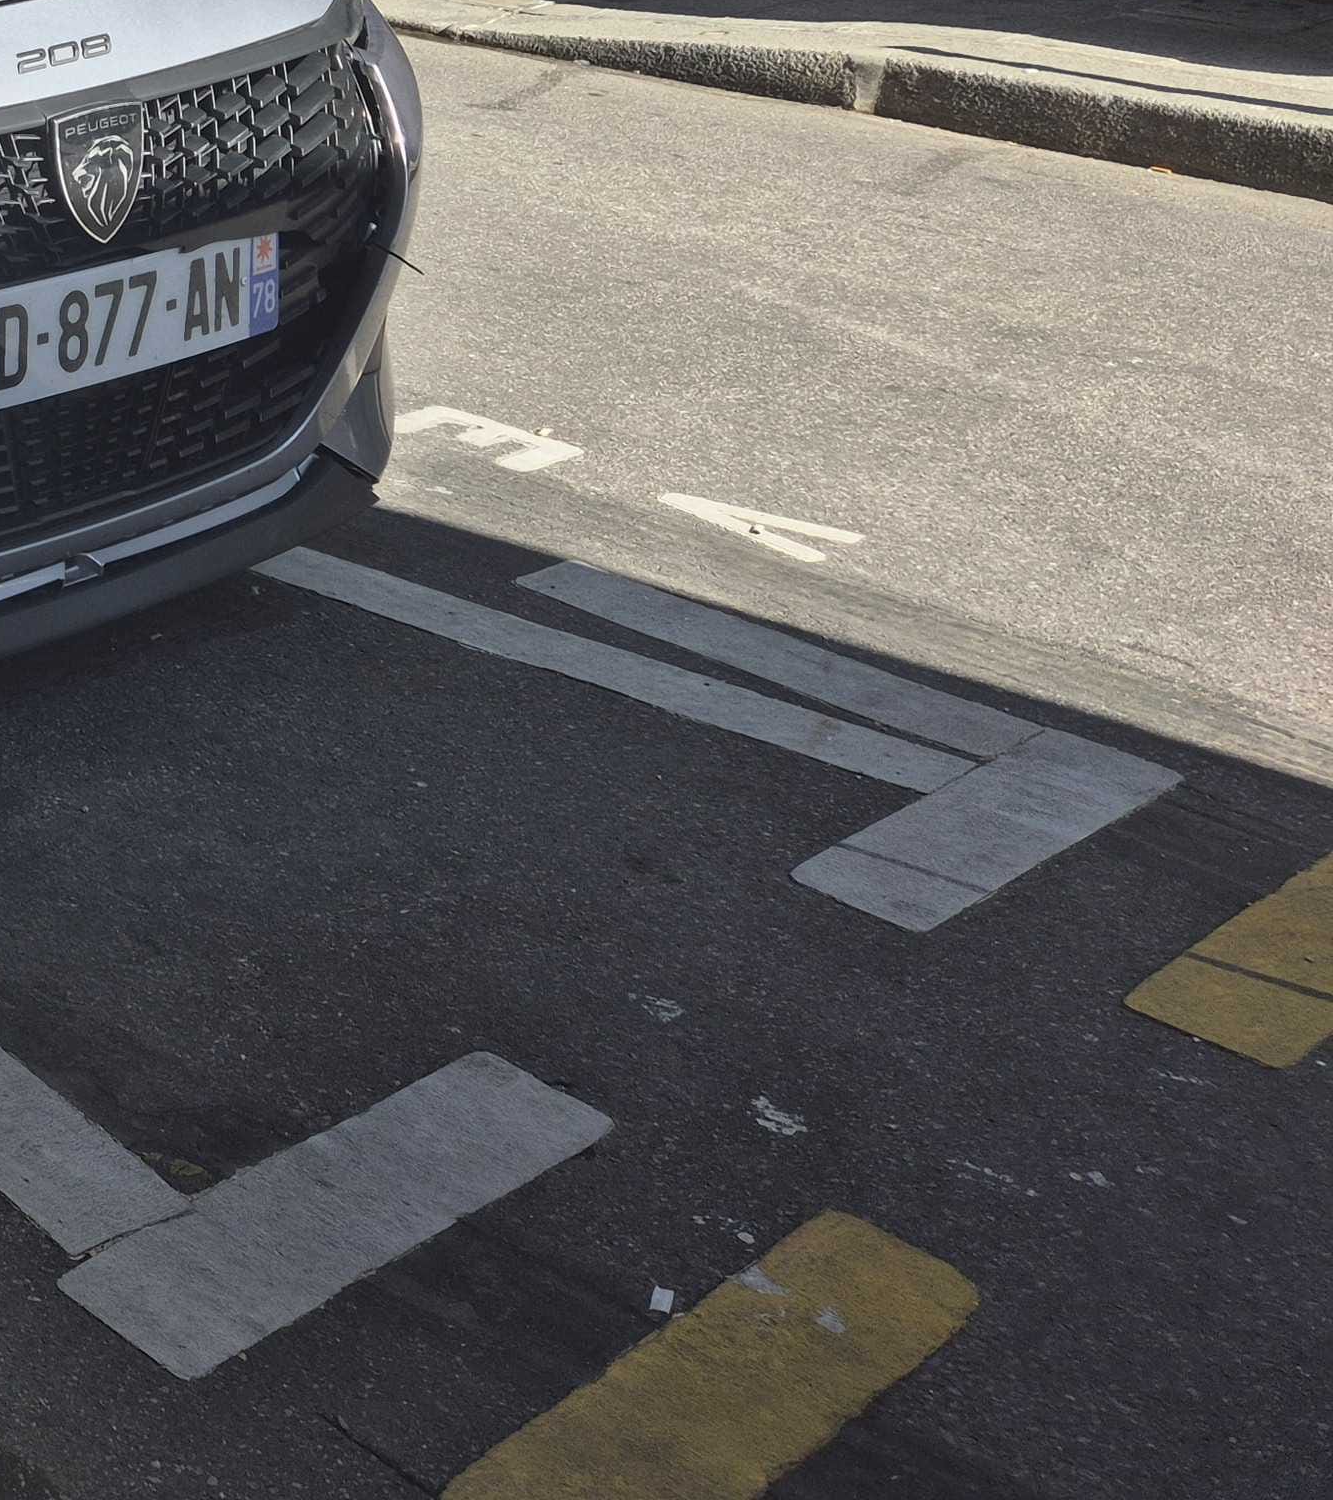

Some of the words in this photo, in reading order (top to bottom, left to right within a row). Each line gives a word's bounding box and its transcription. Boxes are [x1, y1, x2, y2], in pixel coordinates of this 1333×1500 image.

[16, 33, 112, 75] 208
[65, 112, 138, 140] PEUGEOT
[252, 278, 275, 319] 78
